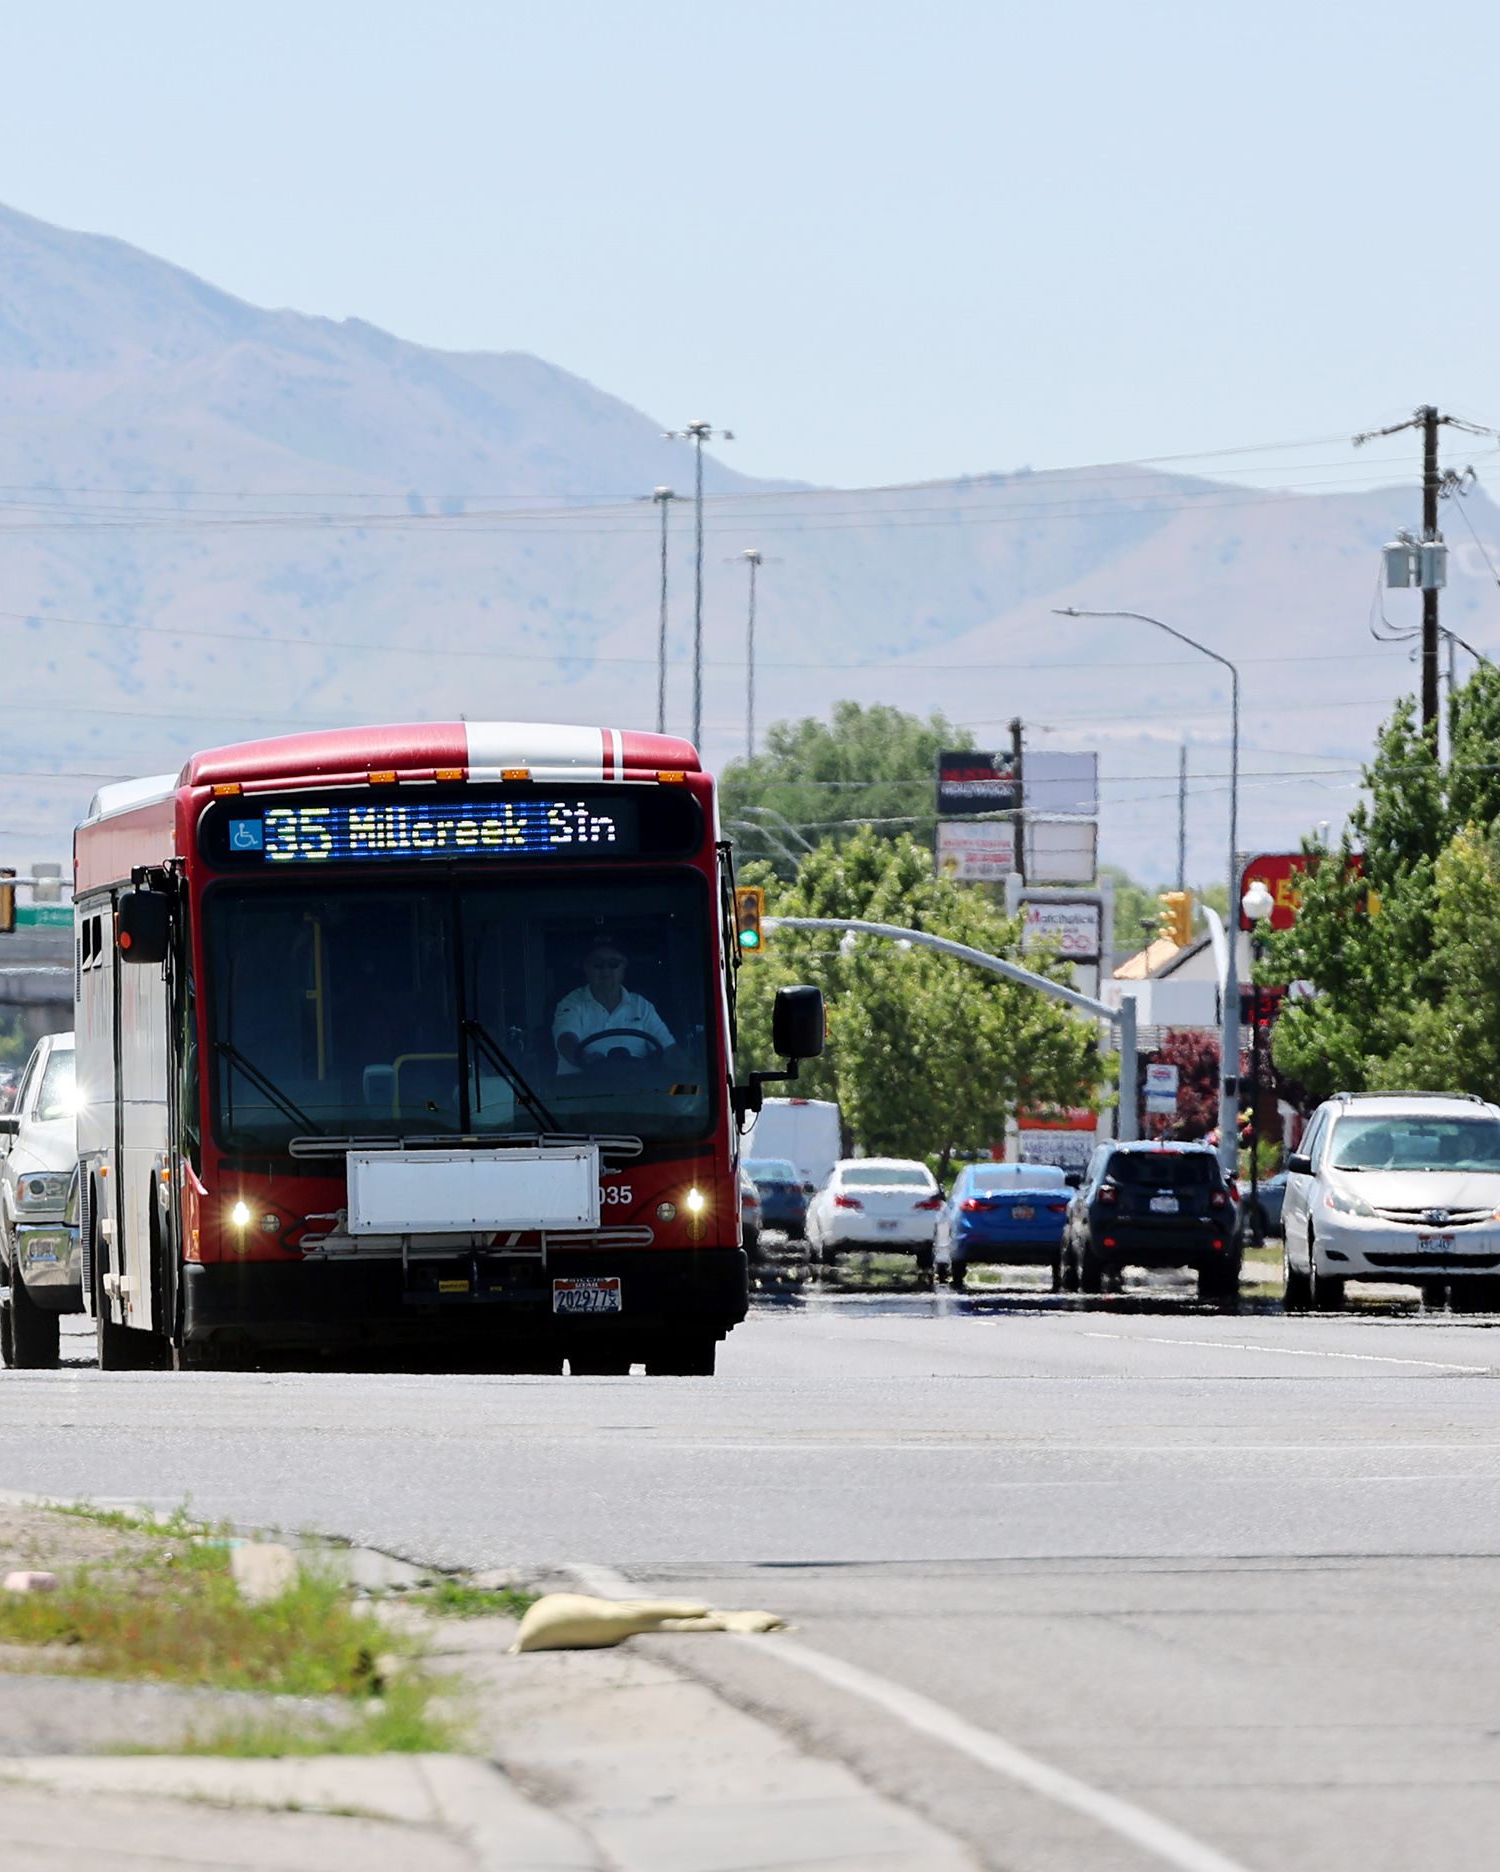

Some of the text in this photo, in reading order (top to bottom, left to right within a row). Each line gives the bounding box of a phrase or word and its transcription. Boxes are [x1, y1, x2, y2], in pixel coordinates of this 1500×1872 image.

[265, 801, 616, 860] 35 Millcreek Stn
[557, 1289, 608, 1308] 202977
